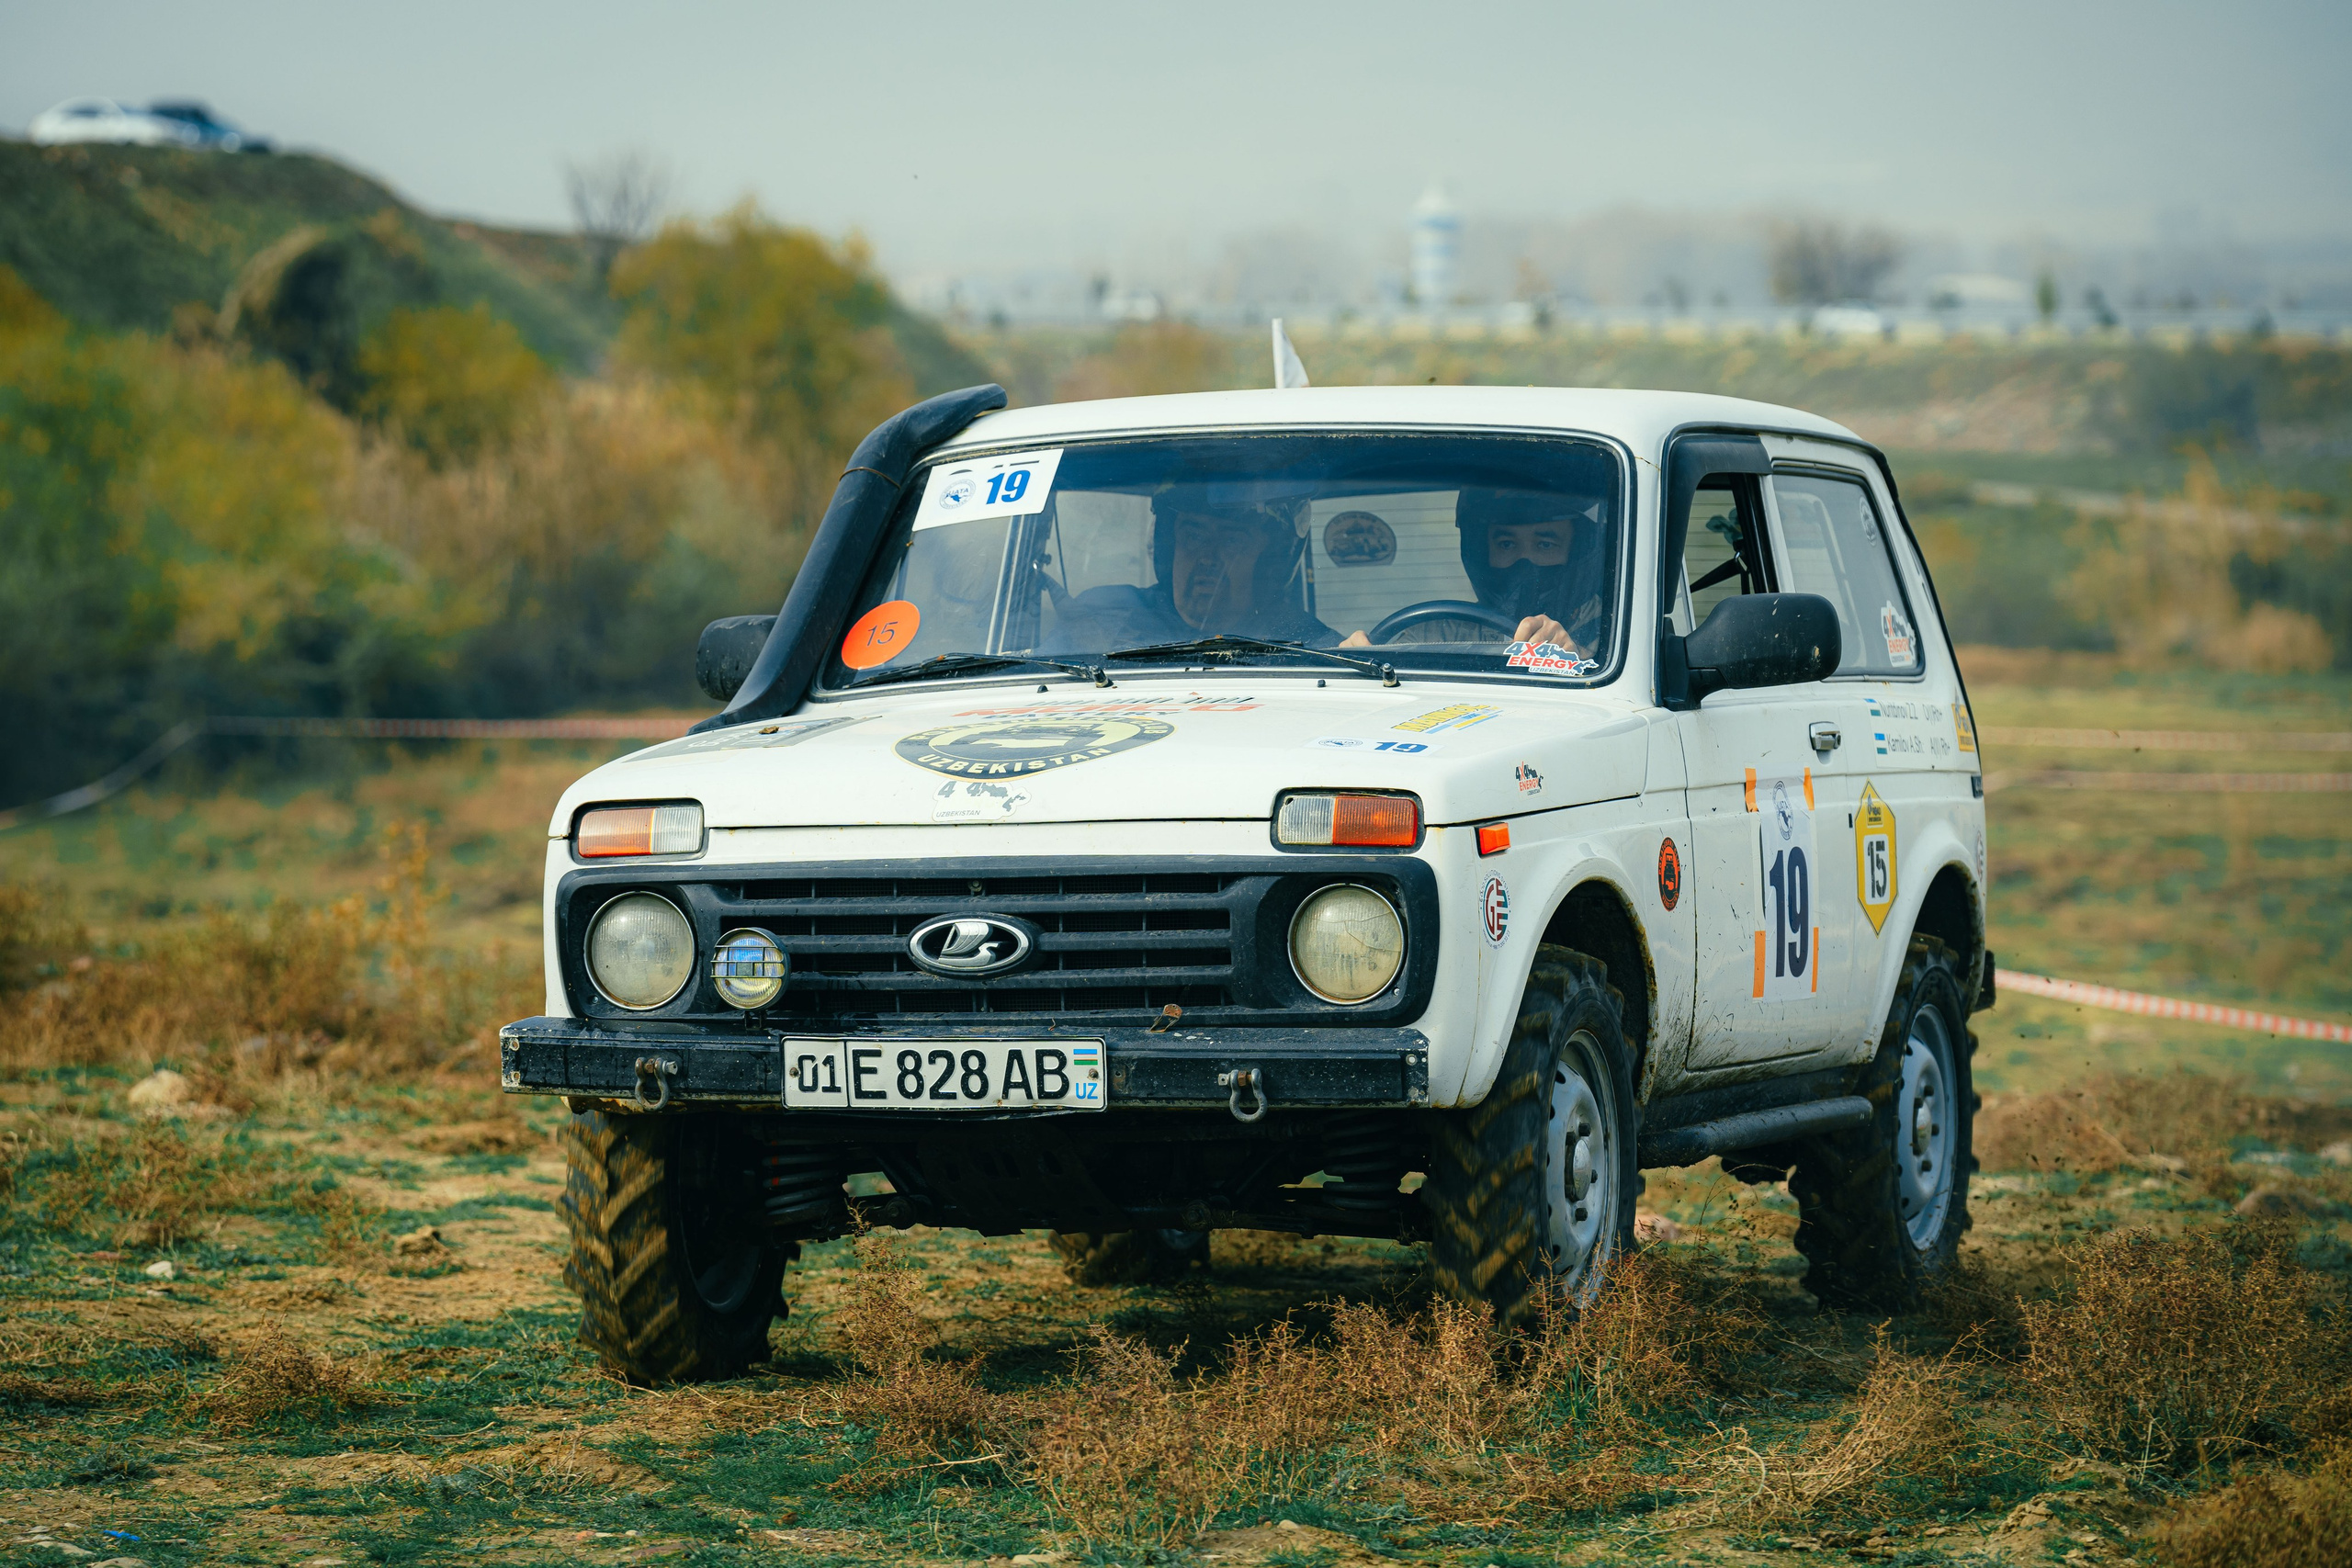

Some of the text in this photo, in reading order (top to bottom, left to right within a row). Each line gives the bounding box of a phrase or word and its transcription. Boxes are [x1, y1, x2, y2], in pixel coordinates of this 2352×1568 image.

[986, 469, 1031, 505] 19
[866, 621, 899, 647] 15
[1888, 637, 1910, 653] ENERGY
[1508, 656, 1578, 670] ENERGY
[1530, 667, 1576, 676] UZBEKISTAN
[1374, 740, 1429, 753] 19
[916, 748, 1114, 774] UZBEKISTAN
[1519, 778, 1540, 792] ENERGY
[1867, 840, 1887, 898] 15
[1769, 846, 1810, 977] 19
[797, 1048, 1070, 1100] 01 E 828 AB
[1075, 1082, 1099, 1100] UZ
